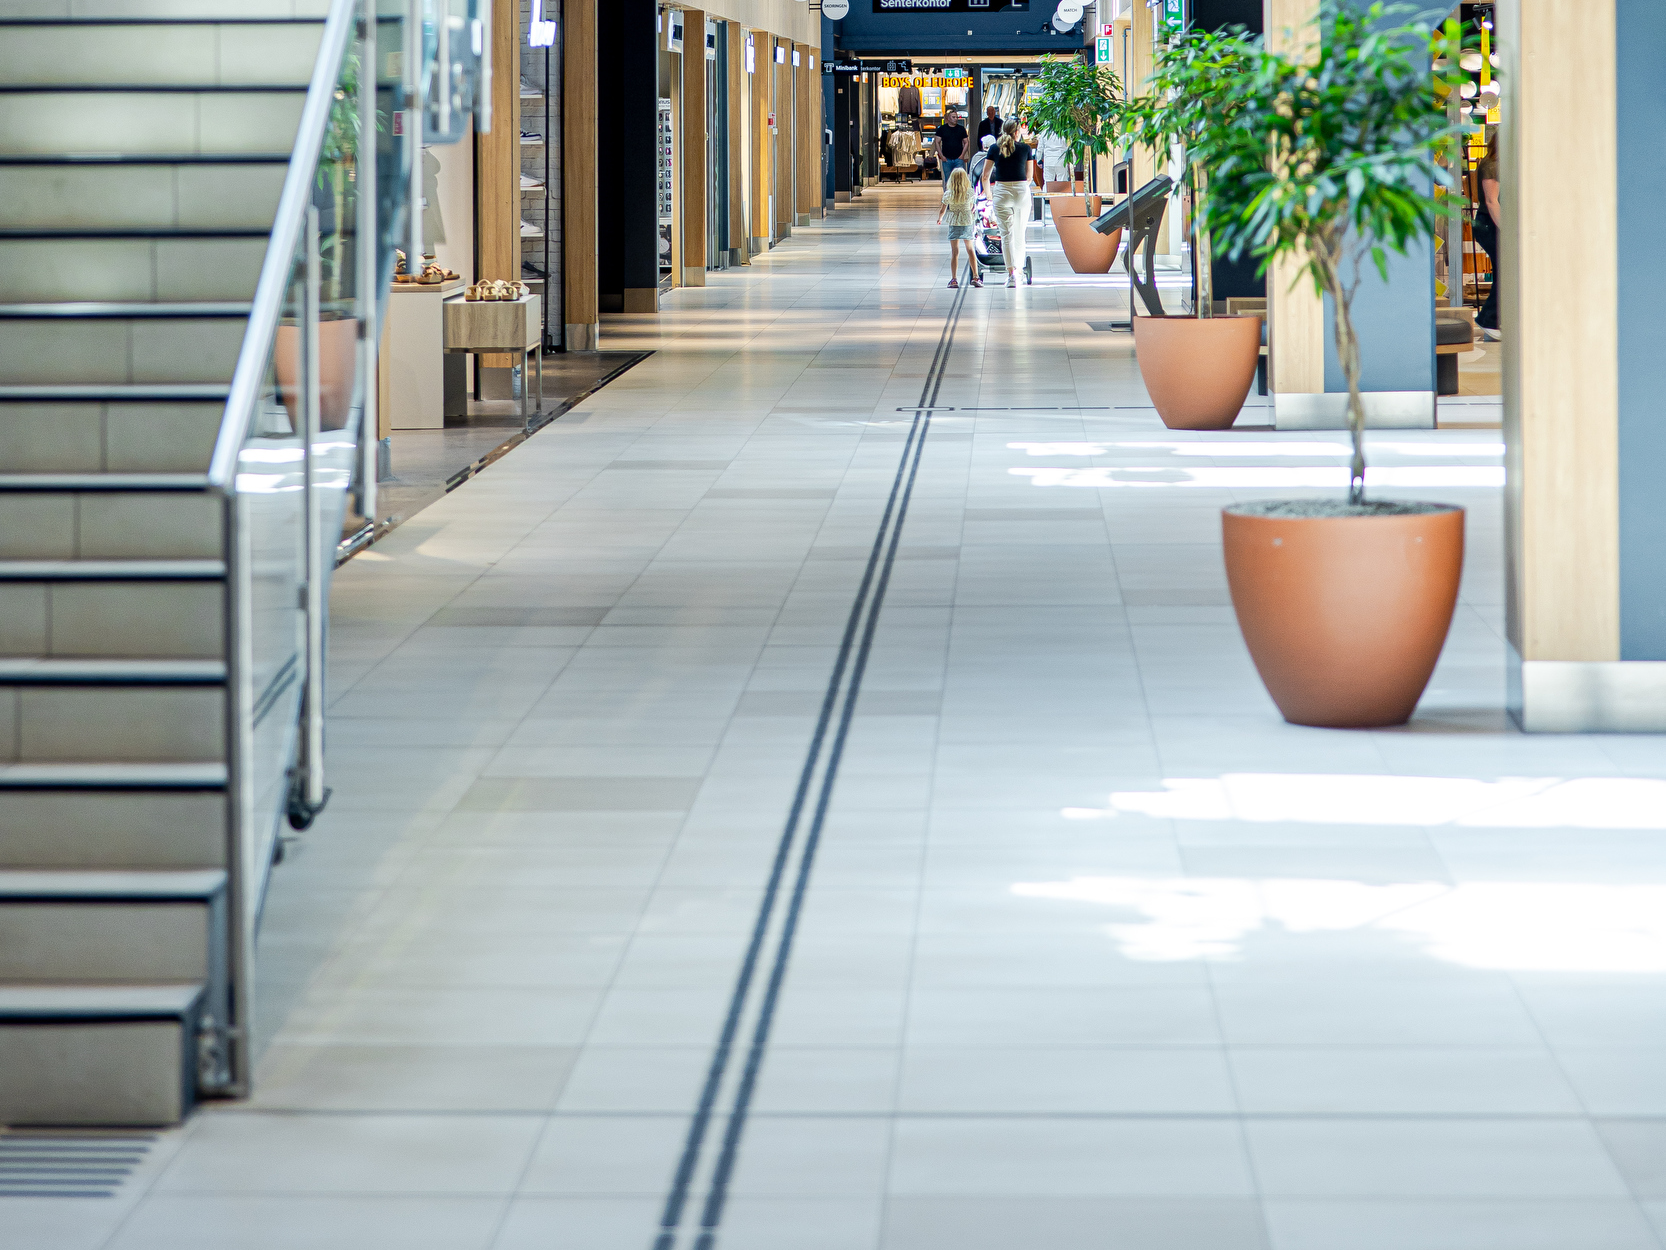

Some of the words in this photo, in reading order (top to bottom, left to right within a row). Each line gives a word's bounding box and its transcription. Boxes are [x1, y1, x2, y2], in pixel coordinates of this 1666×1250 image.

[882, 77, 911, 88] BOYS
[914, 77, 928, 88] OF
[931, 77, 974, 88] EUROPE
